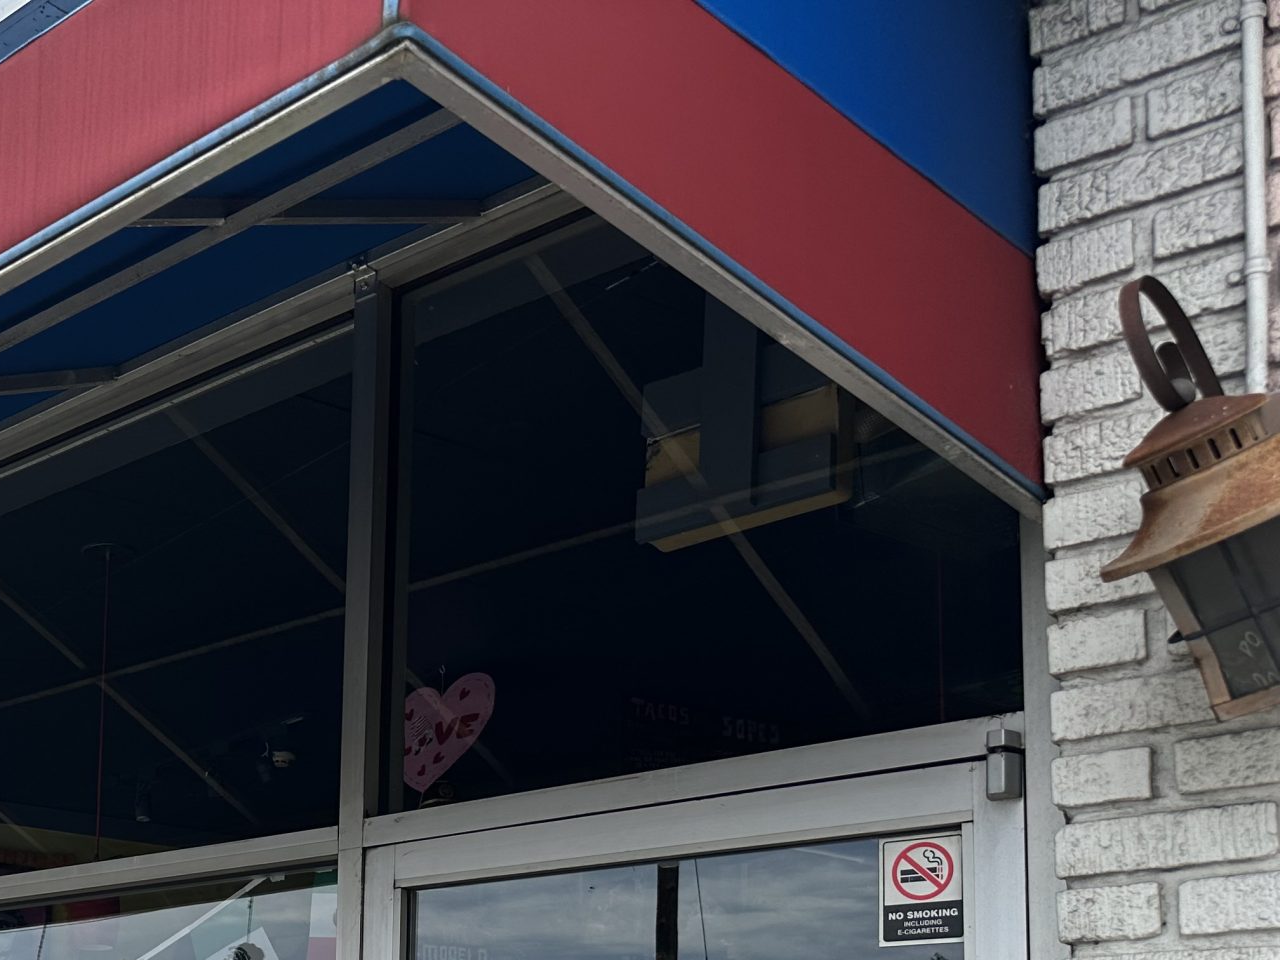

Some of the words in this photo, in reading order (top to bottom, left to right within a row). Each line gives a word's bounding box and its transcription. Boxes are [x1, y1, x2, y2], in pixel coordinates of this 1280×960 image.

[888, 911, 904, 921] NO
[906, 908, 958, 919] SMOKING
[903, 918, 942, 927] INCLUDING
[897, 926, 949, 936] E-CIGARETTES
